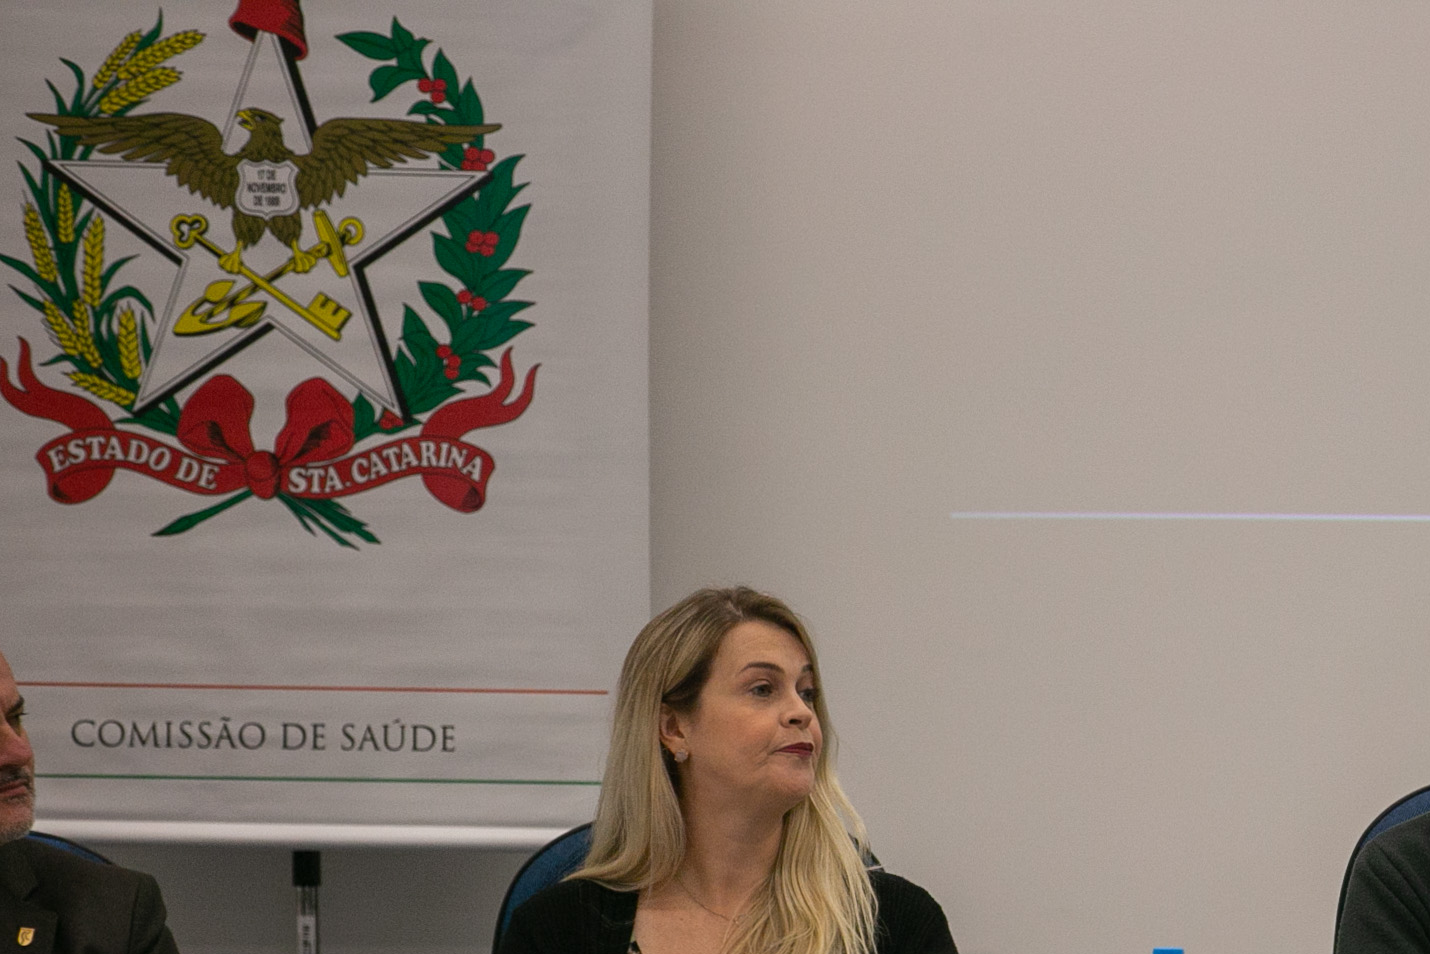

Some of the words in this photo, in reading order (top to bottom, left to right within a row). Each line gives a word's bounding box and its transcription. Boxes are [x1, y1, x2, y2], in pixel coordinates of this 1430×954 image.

[47, 435, 172, 473] ESTADO
[174, 456, 220, 490] DE
[287, 465, 351, 494] STA.
[351, 439, 483, 483] CATARINA
[70, 716, 267, 751] COMISSÃO
[281, 722, 327, 752] DE
[339, 717, 457, 753] SAÚDE
